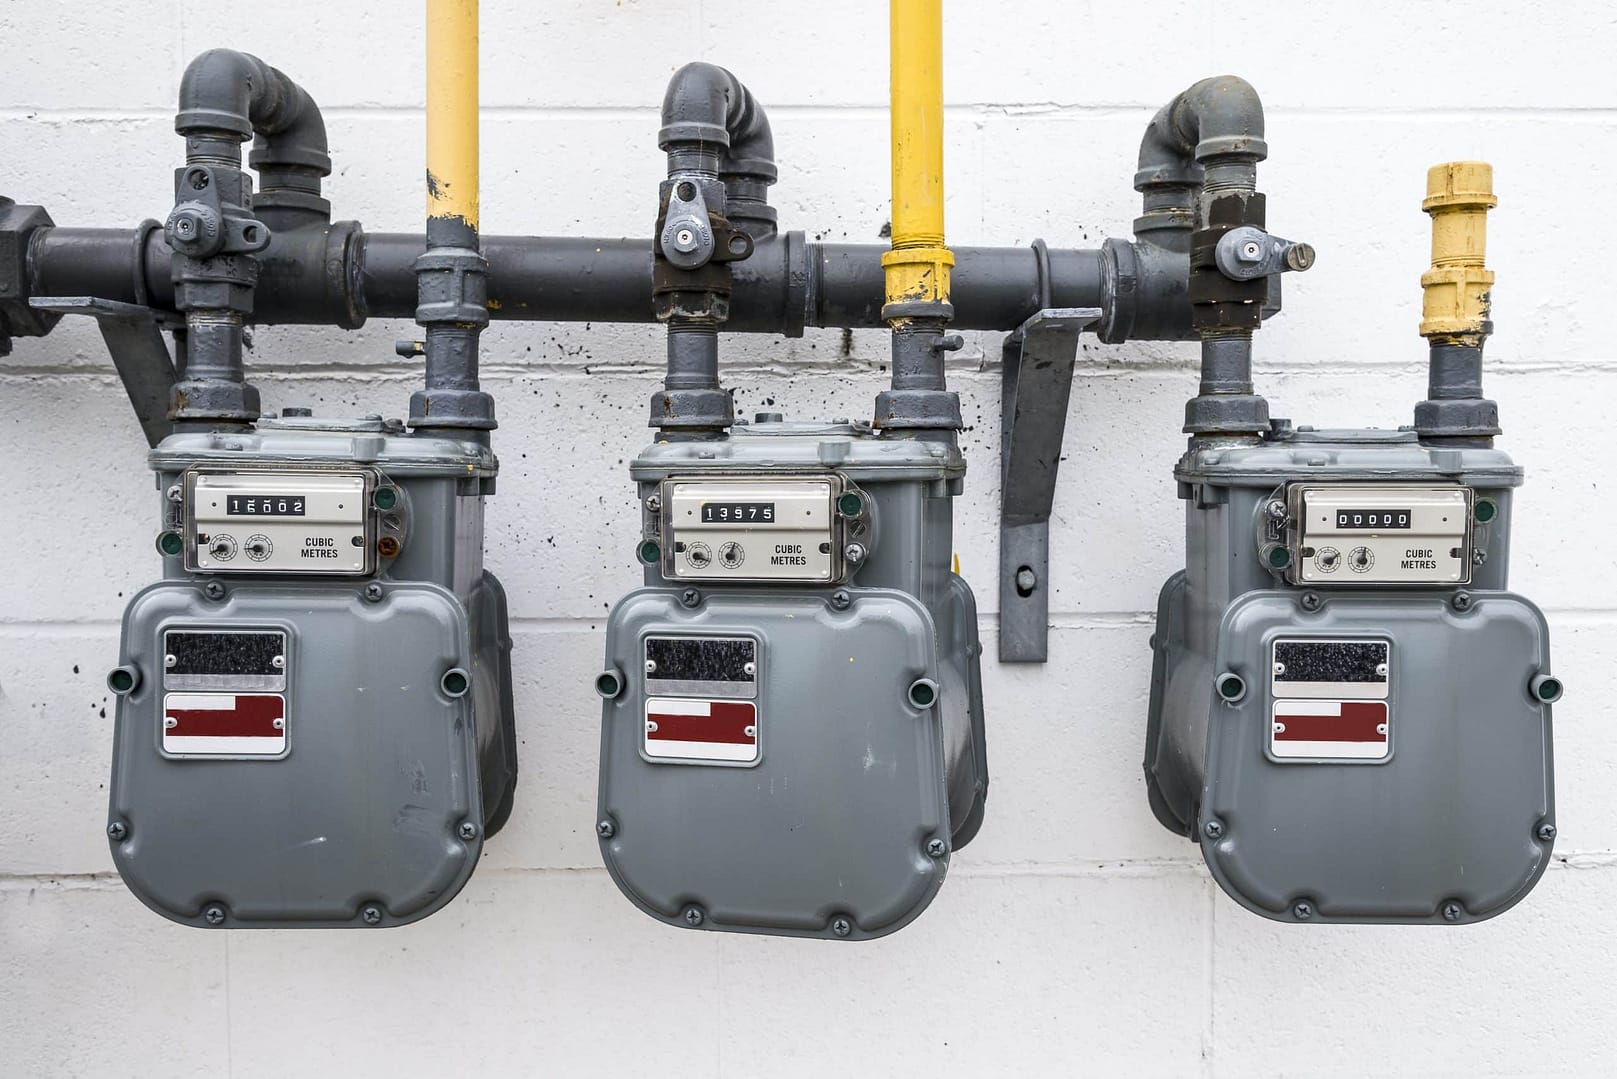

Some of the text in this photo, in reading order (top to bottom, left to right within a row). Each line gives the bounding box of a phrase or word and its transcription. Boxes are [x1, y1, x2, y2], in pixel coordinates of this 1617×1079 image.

[706, 508, 773, 520] 13975
[1339, 514, 1407, 524] 00000
[305, 537, 334, 547] CUBIC
[301, 549, 338, 558] METRES
[775, 544, 802, 554] CUBIC
[1405, 549, 1433, 558] CUBIC
[771, 556, 807, 565] METRES
[1401, 560, 1437, 569] METRES
